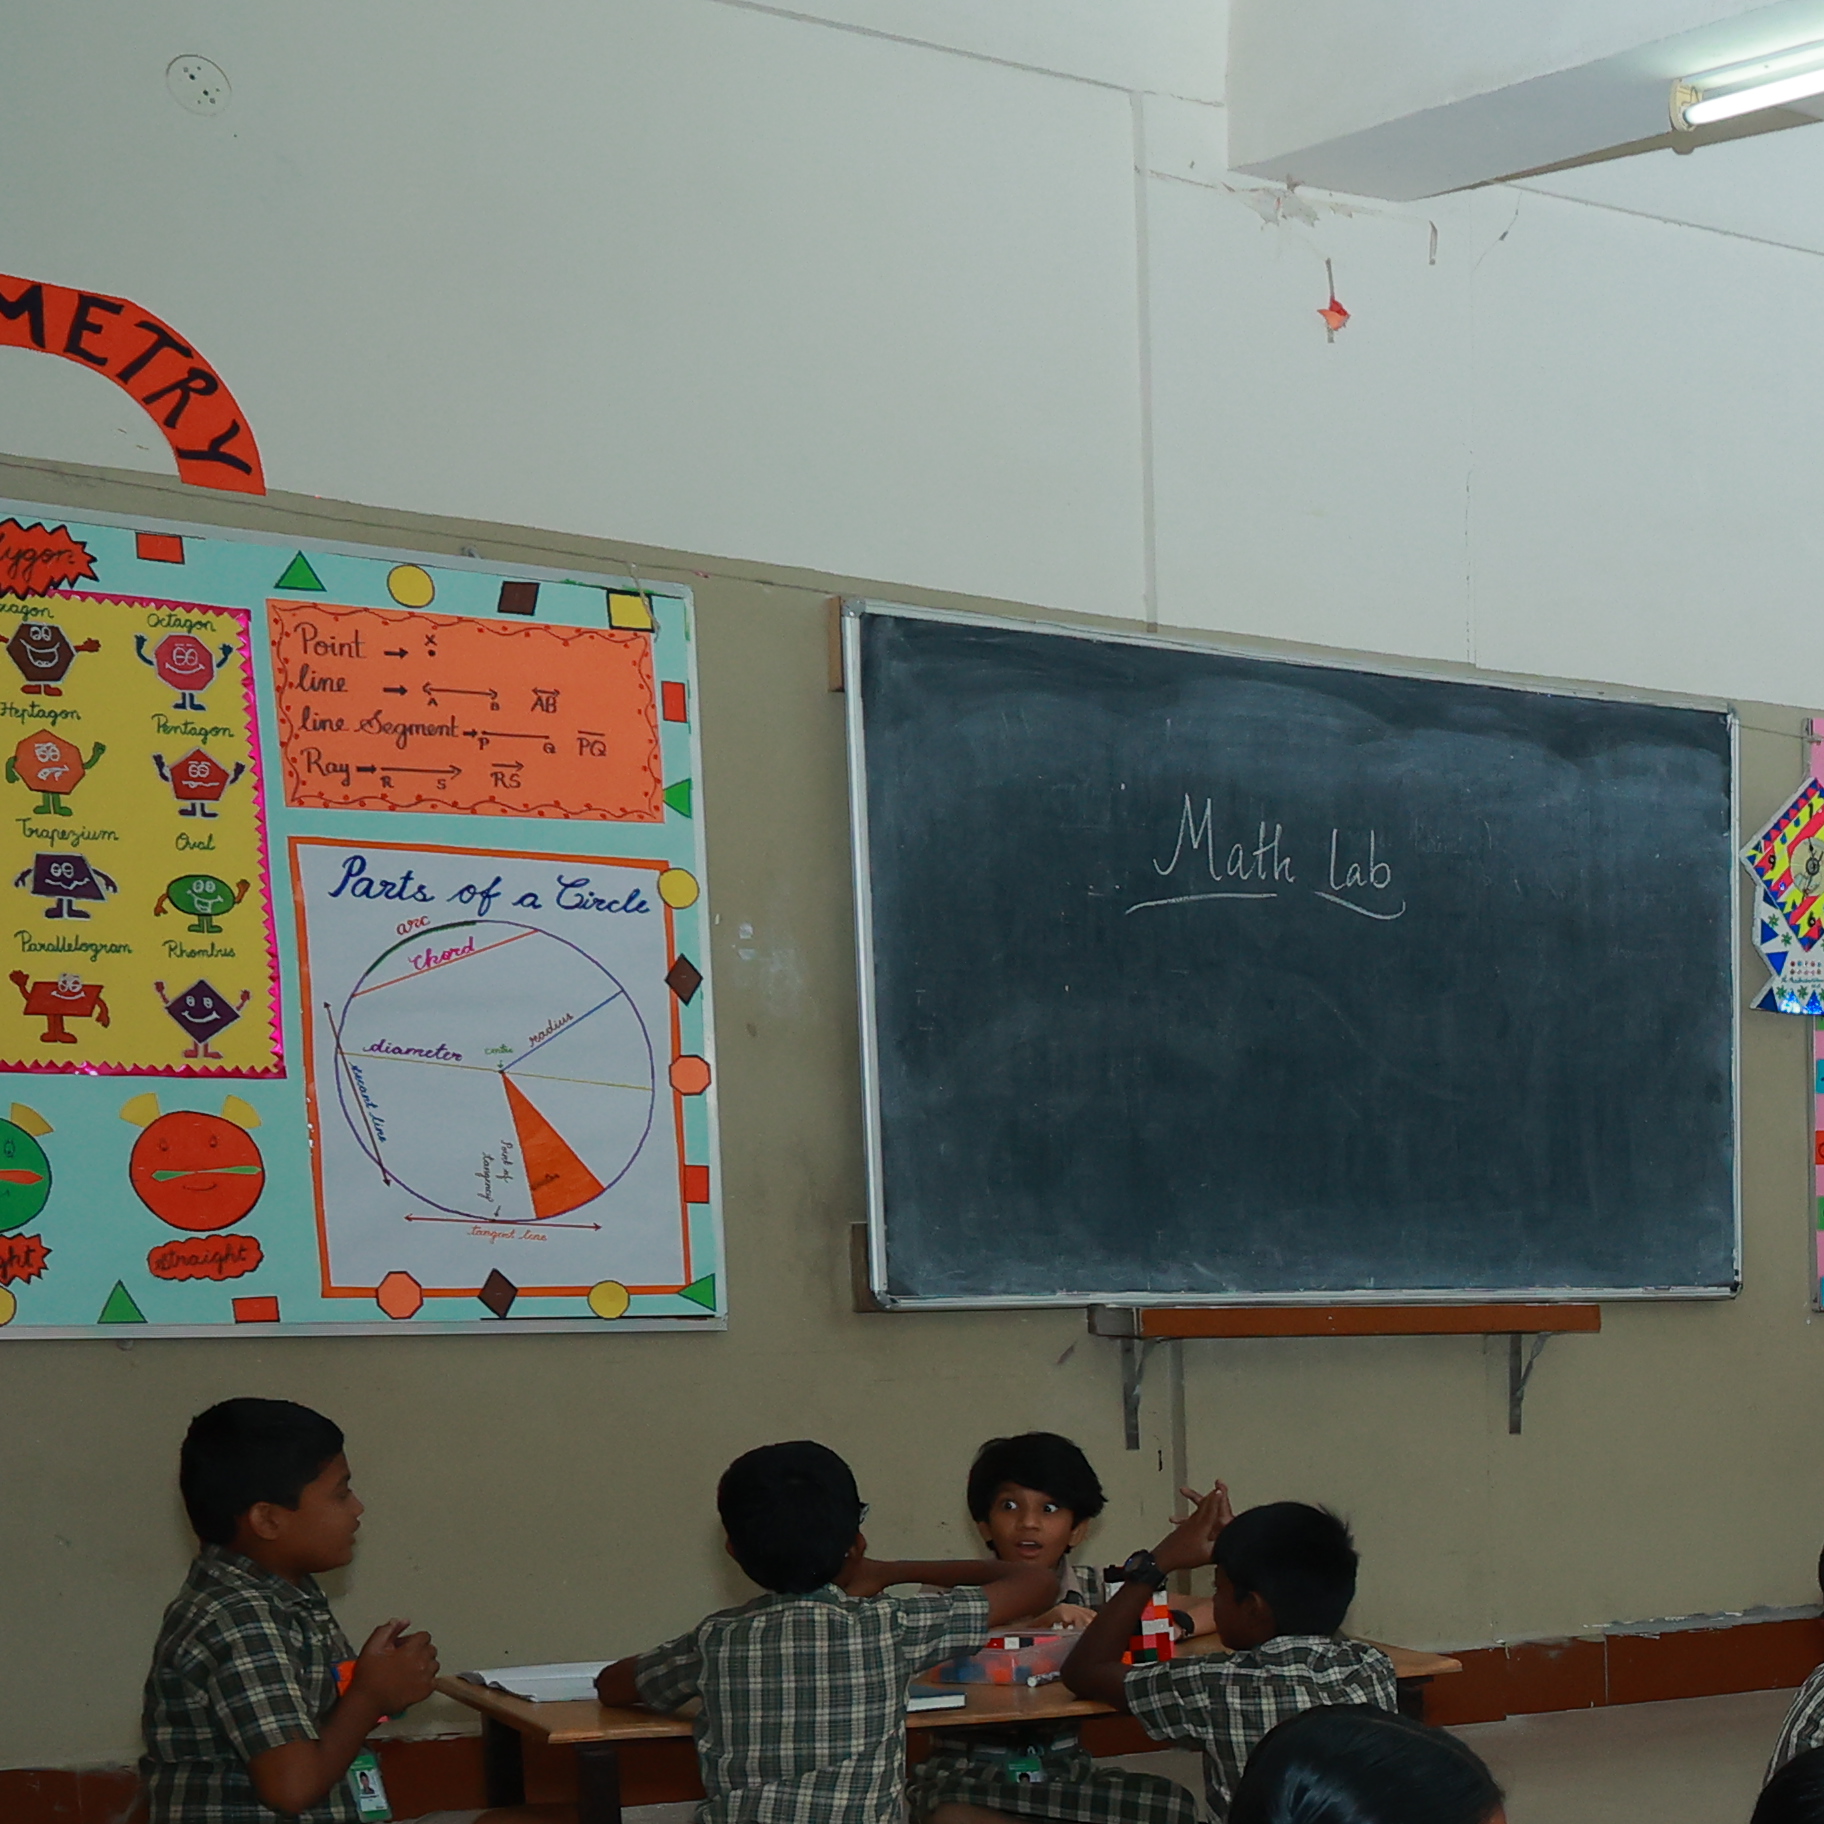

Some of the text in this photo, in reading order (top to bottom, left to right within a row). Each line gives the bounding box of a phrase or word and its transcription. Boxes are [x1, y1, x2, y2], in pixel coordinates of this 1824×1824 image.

[147, 613, 217, 634] Octagon
[294, 622, 367, 659] Point
[295, 663, 349, 693] line
[152, 713, 235, 745] Pentagon
[298, 705, 352, 732] line
[577, 737, 608, 758] PQ
[300, 747, 351, 787] Ray
[492, 771, 521, 790] RS
[15, 817, 119, 847] Trapezium
[175, 833, 216, 851] Oval
[1153, 792, 1296, 883] Math
[328, 855, 652, 917] Parts of a Circle
[14, 930, 133, 962] Parallelogram
[363, 1038, 464, 1062] diameter
